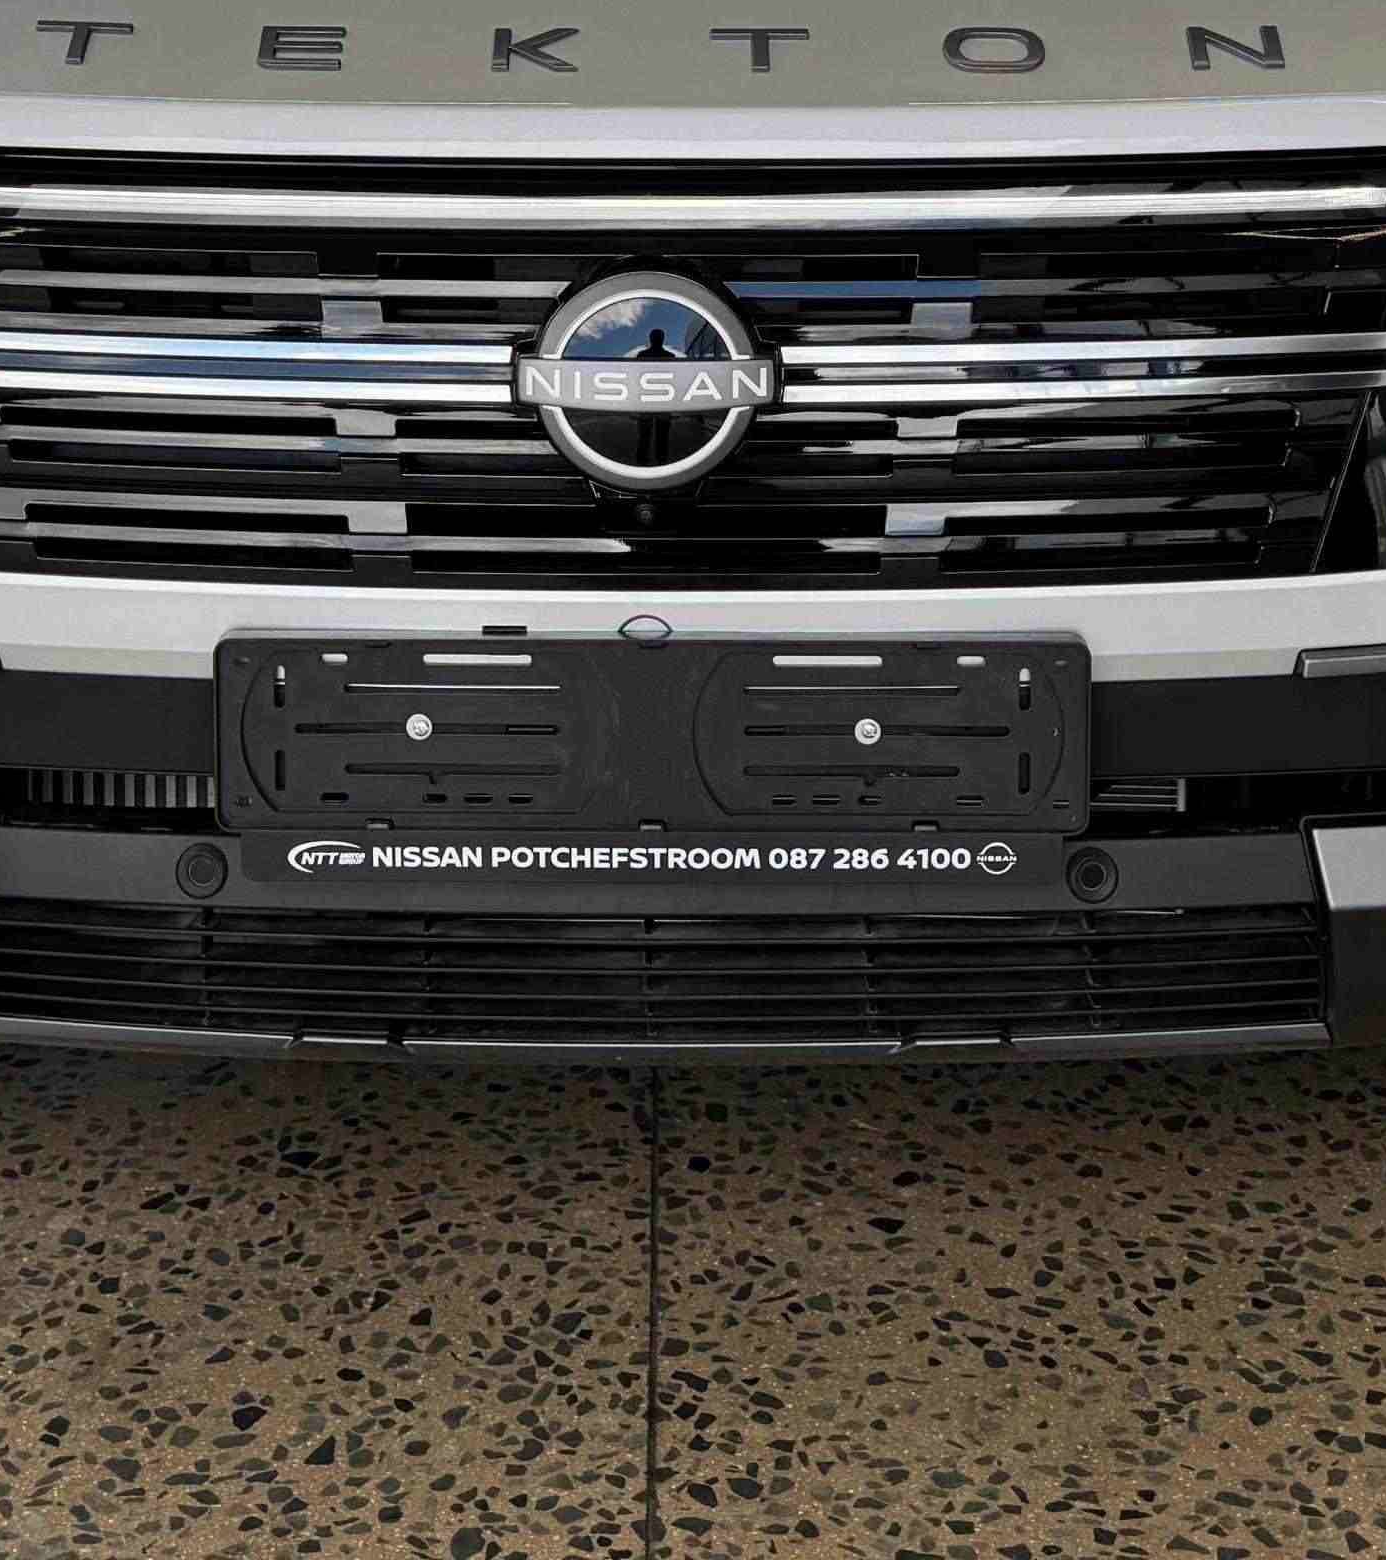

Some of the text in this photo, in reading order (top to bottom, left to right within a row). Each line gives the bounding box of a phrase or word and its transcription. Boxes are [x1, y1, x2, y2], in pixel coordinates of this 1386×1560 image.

[37, 19, 1284, 73] TEKTON
[524, 366, 768, 403] NISSAN
[300, 851, 340, 865] NTT
[372, 846, 483, 868] NISSAN
[491, 846, 762, 869] POTCHEFSTROOM
[768, 848, 826, 870] 087
[833, 848, 889, 870] 286
[897, 848, 972, 870] 4100
